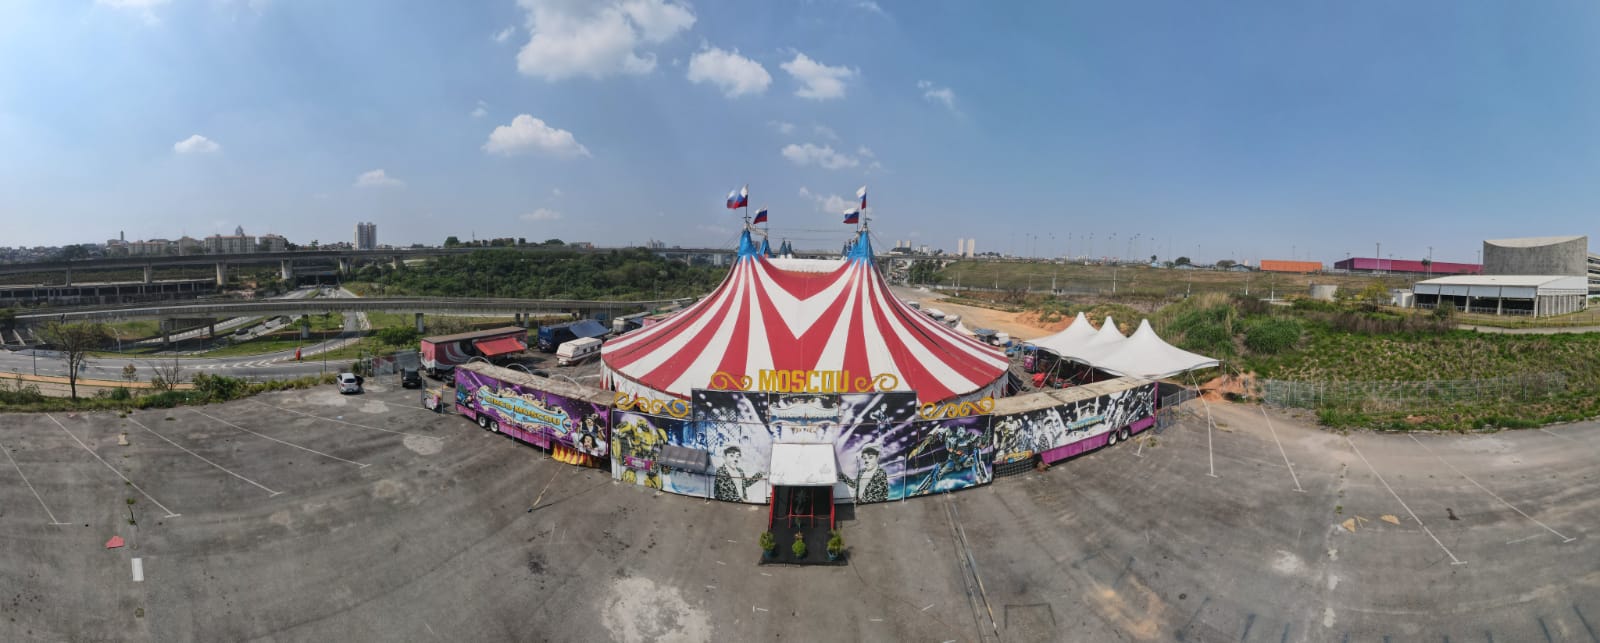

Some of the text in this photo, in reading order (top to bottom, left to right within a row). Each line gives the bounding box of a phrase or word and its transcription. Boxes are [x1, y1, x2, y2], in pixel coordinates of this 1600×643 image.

[758, 369, 850, 393] MOSCOU
[484, 395, 561, 426] CIRCO MOSCOU
